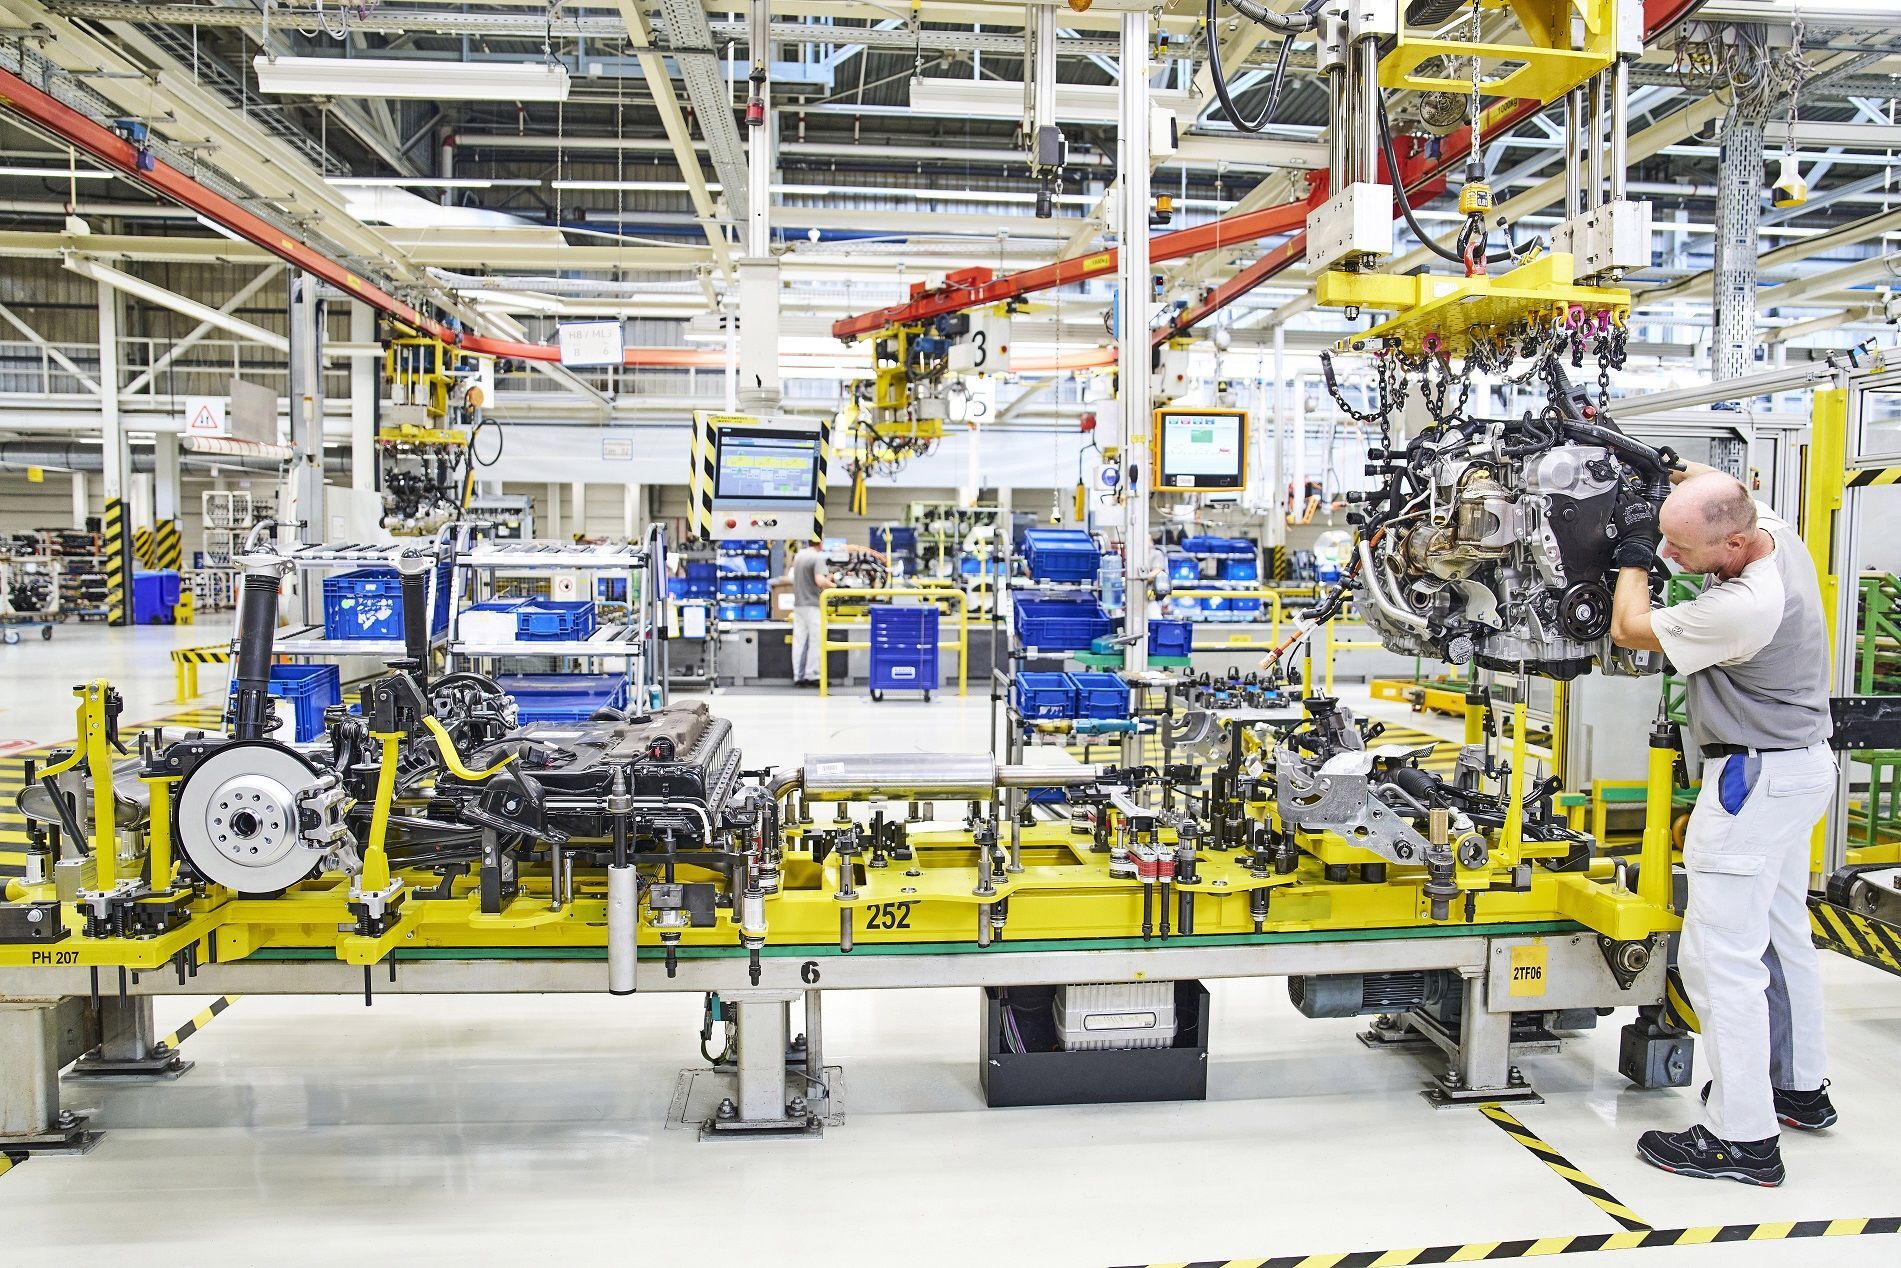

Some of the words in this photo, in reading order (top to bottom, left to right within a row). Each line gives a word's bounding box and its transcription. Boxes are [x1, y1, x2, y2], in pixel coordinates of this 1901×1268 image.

[972, 330, 986, 367] 3
[866, 902, 911, 930] 252
[32, 951, 52, 964] PH
[56, 951, 80, 965] 207
[800, 961, 820, 985] 6
[1513, 966, 1542, 981] 2TF06
